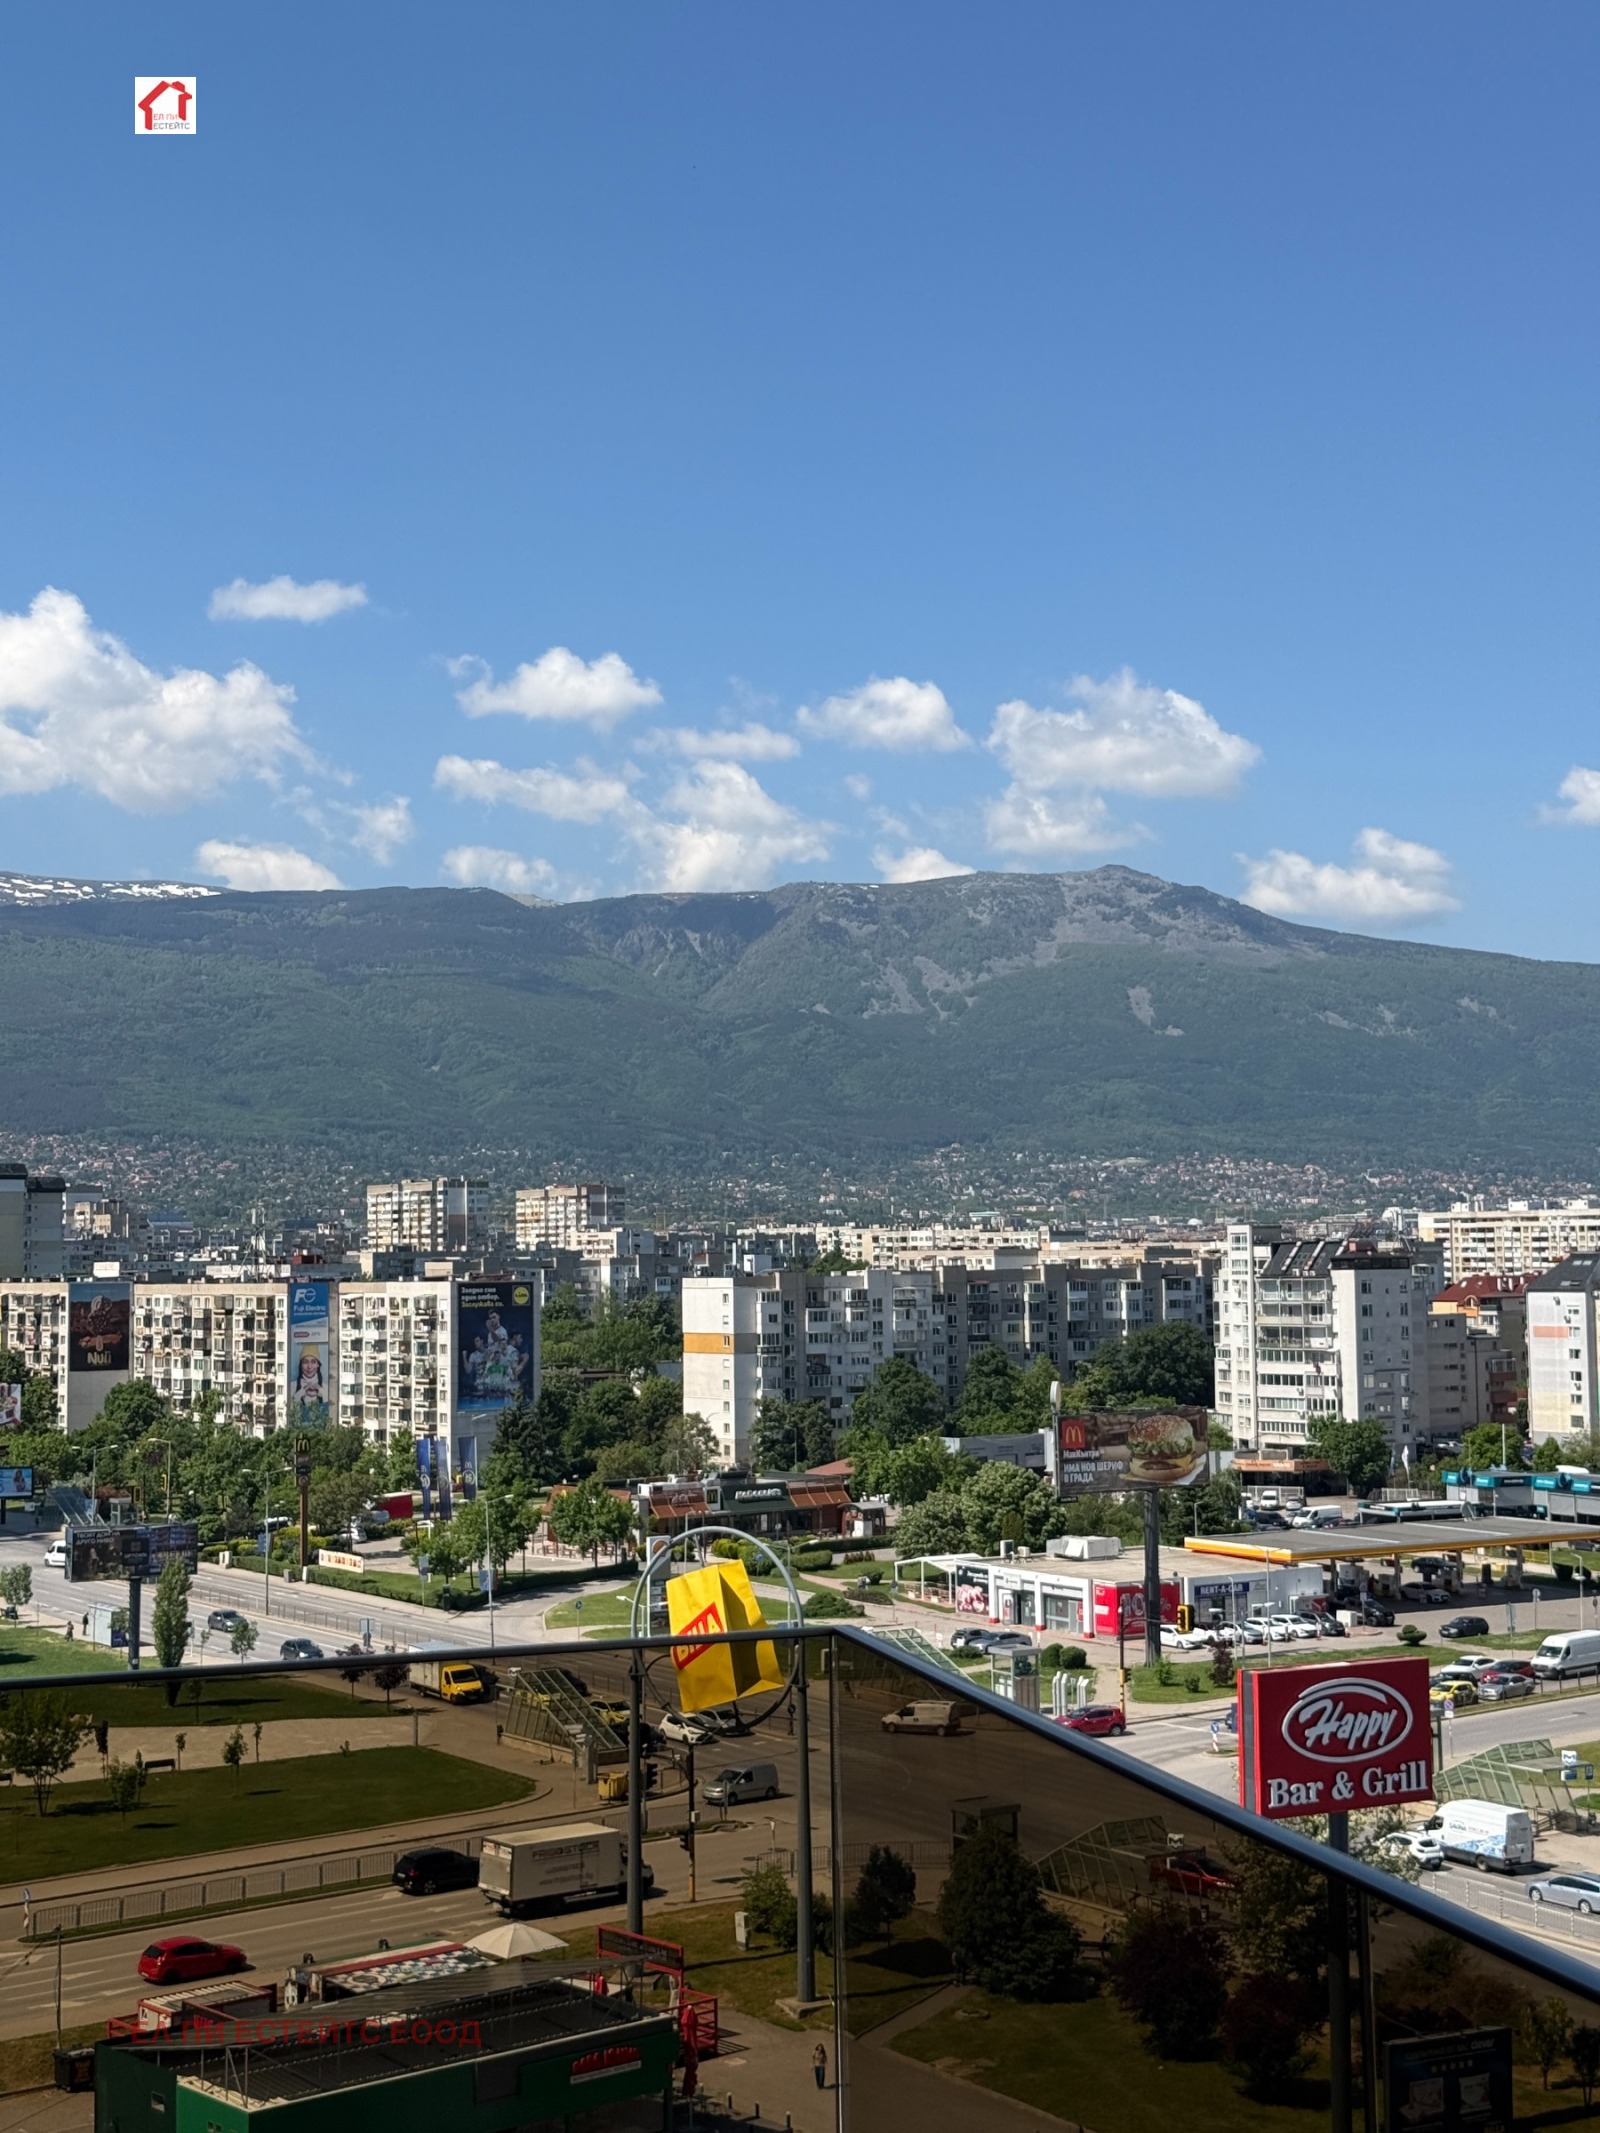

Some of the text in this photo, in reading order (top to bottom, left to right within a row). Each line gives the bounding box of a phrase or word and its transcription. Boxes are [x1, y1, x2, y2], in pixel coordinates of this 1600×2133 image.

[1064, 1461, 1124, 1472] ИМА НОВ ШЕРИФ
[1064, 1473, 1094, 1483] В ГРАДА
[1200, 1583, 1243, 1595] RENT-A-CAR
[1299, 1698, 1397, 1750] Happy
[1268, 1760, 1428, 1808] Bar & Grill
